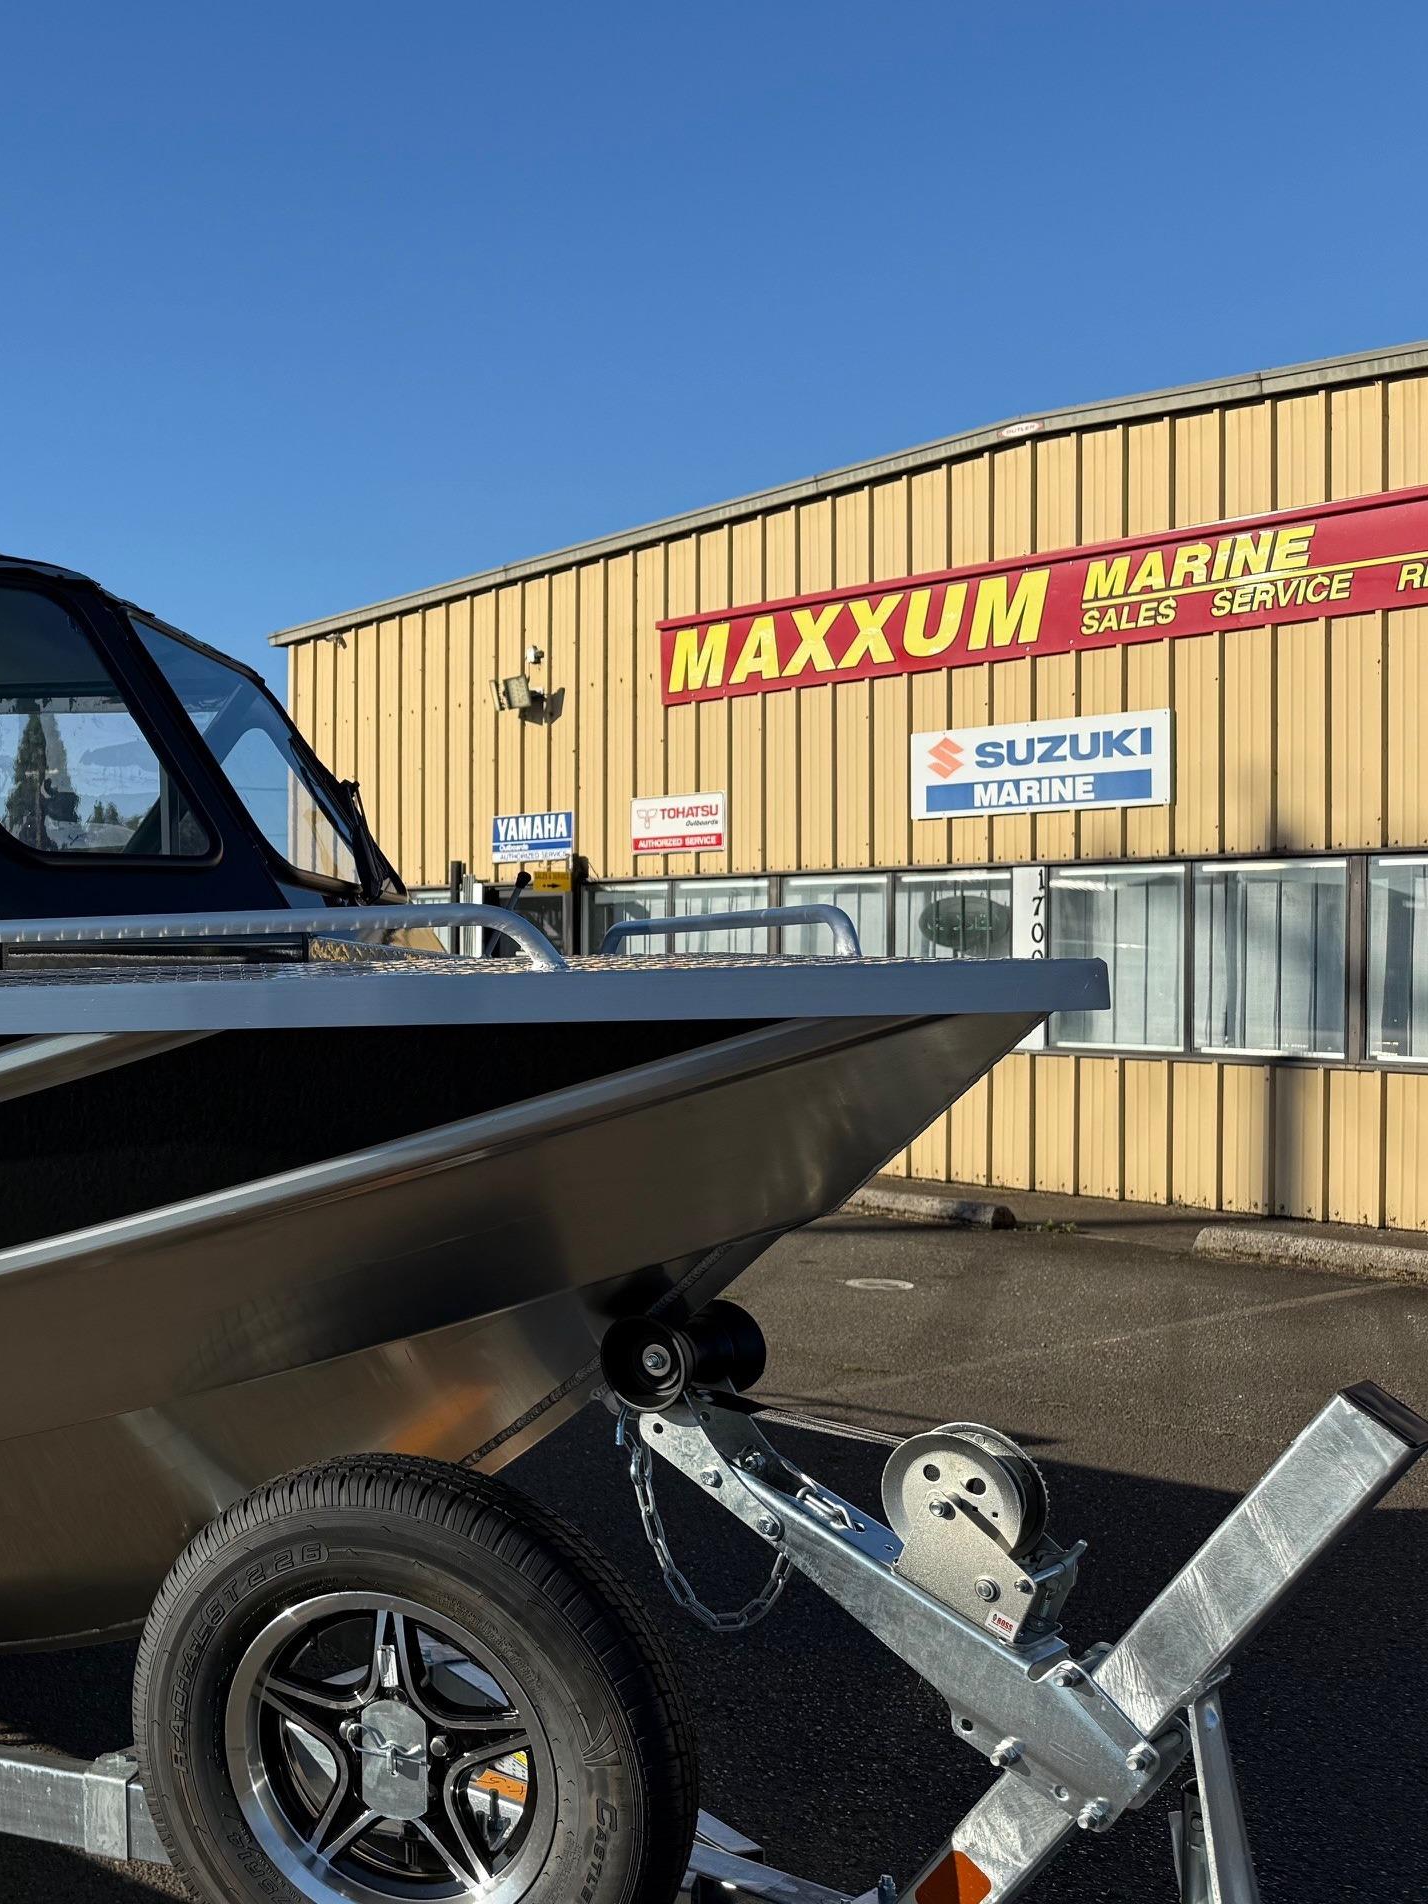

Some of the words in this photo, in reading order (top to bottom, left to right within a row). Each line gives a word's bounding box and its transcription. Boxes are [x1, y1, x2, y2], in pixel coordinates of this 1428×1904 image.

[1081, 524, 1316, 602] MARINE
[1080, 597, 1178, 636] SALES
[1210, 571, 1354, 618] SERVICE
[1396, 560, 1428, 592] R
[667, 568, 1051, 694] MAXXUM
[974, 726, 1152, 770] SUZUKI
[973, 775, 1095, 807] MARINE
[497, 813, 568, 842] YAMAHA
[659, 804, 719, 820] TOHATSU
[685, 819, 719, 827] Outboards
[638, 837, 683, 849] AUTHORIZED
[684, 834, 717, 846] SERVICE
